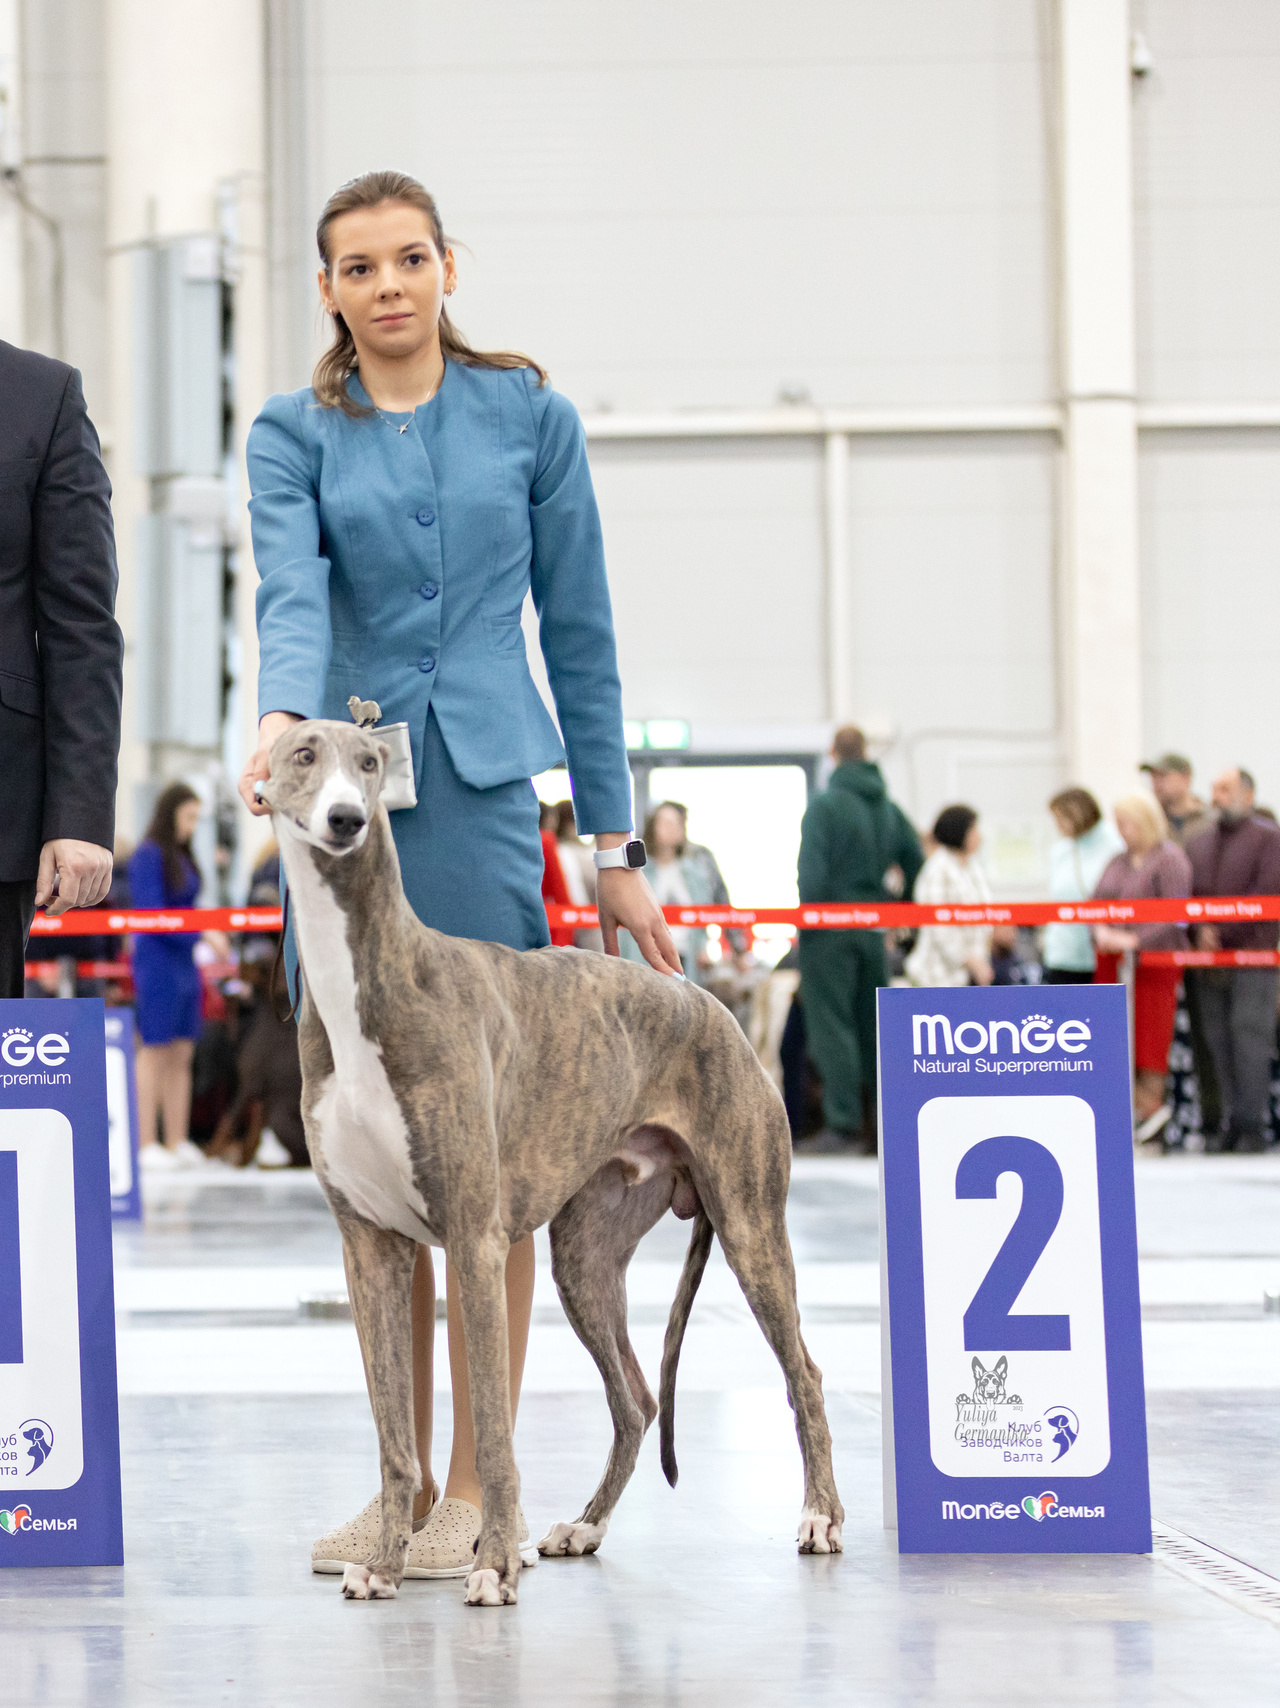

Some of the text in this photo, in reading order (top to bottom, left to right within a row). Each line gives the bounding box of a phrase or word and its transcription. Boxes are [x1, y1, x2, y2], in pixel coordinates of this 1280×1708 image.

[913, 1058, 1093, 1075] Natural Superpremium
[955, 1135, 1072, 1352] 2
[1008, 1420, 1042, 1435] Клуб
[960, 1436, 1043, 1449] Заводчиков
[1003, 1450, 1043, 1463] Валта
[1045, 1502, 1105, 1518] Семья
[20, 1515, 78, 1531] Семья
